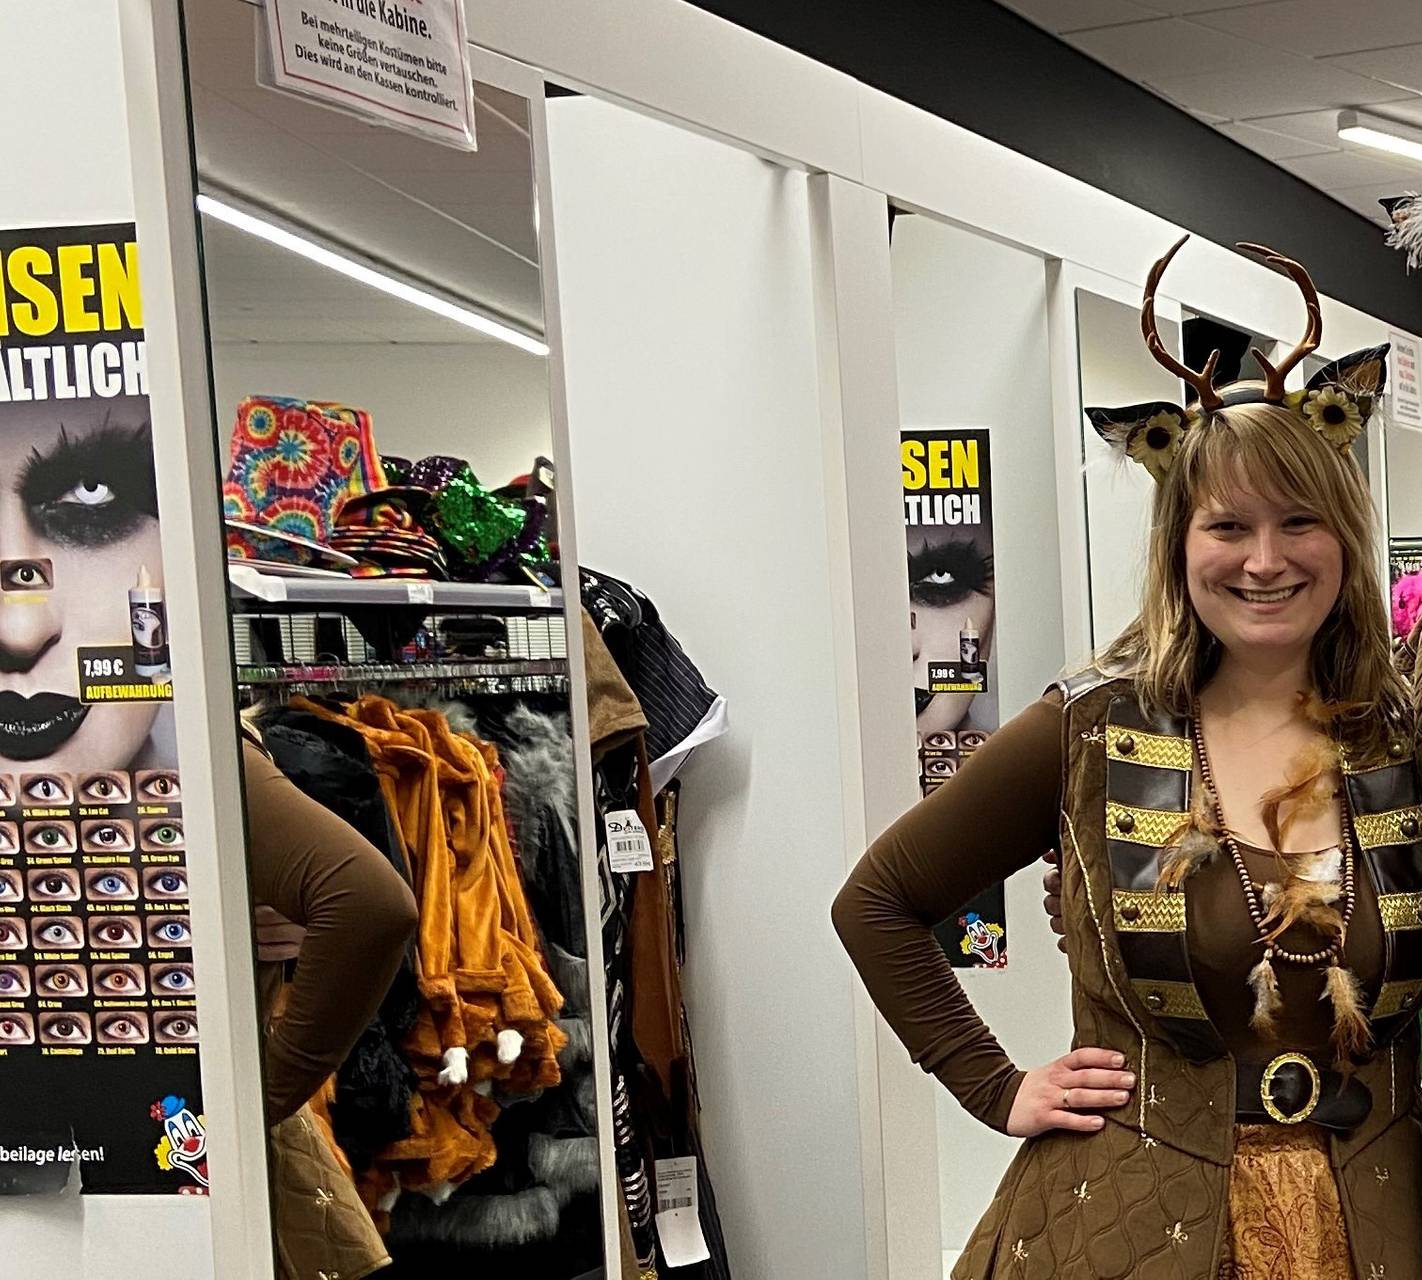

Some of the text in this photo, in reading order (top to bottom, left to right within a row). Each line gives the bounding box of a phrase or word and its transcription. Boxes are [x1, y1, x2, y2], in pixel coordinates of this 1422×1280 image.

[301, 11, 447, 75] Bei mehrteiligen Kostümen bitte
[379, 0, 432, 39] Kabine.
[295, 44, 459, 111] Dies wird an den Kassen kontrolliert.
[318, 33, 438, 88] keine Größen vertauschen.
[83, 659, 112, 677] 7,99
[86, 683, 173, 699] AUFBEWAHRUNG
